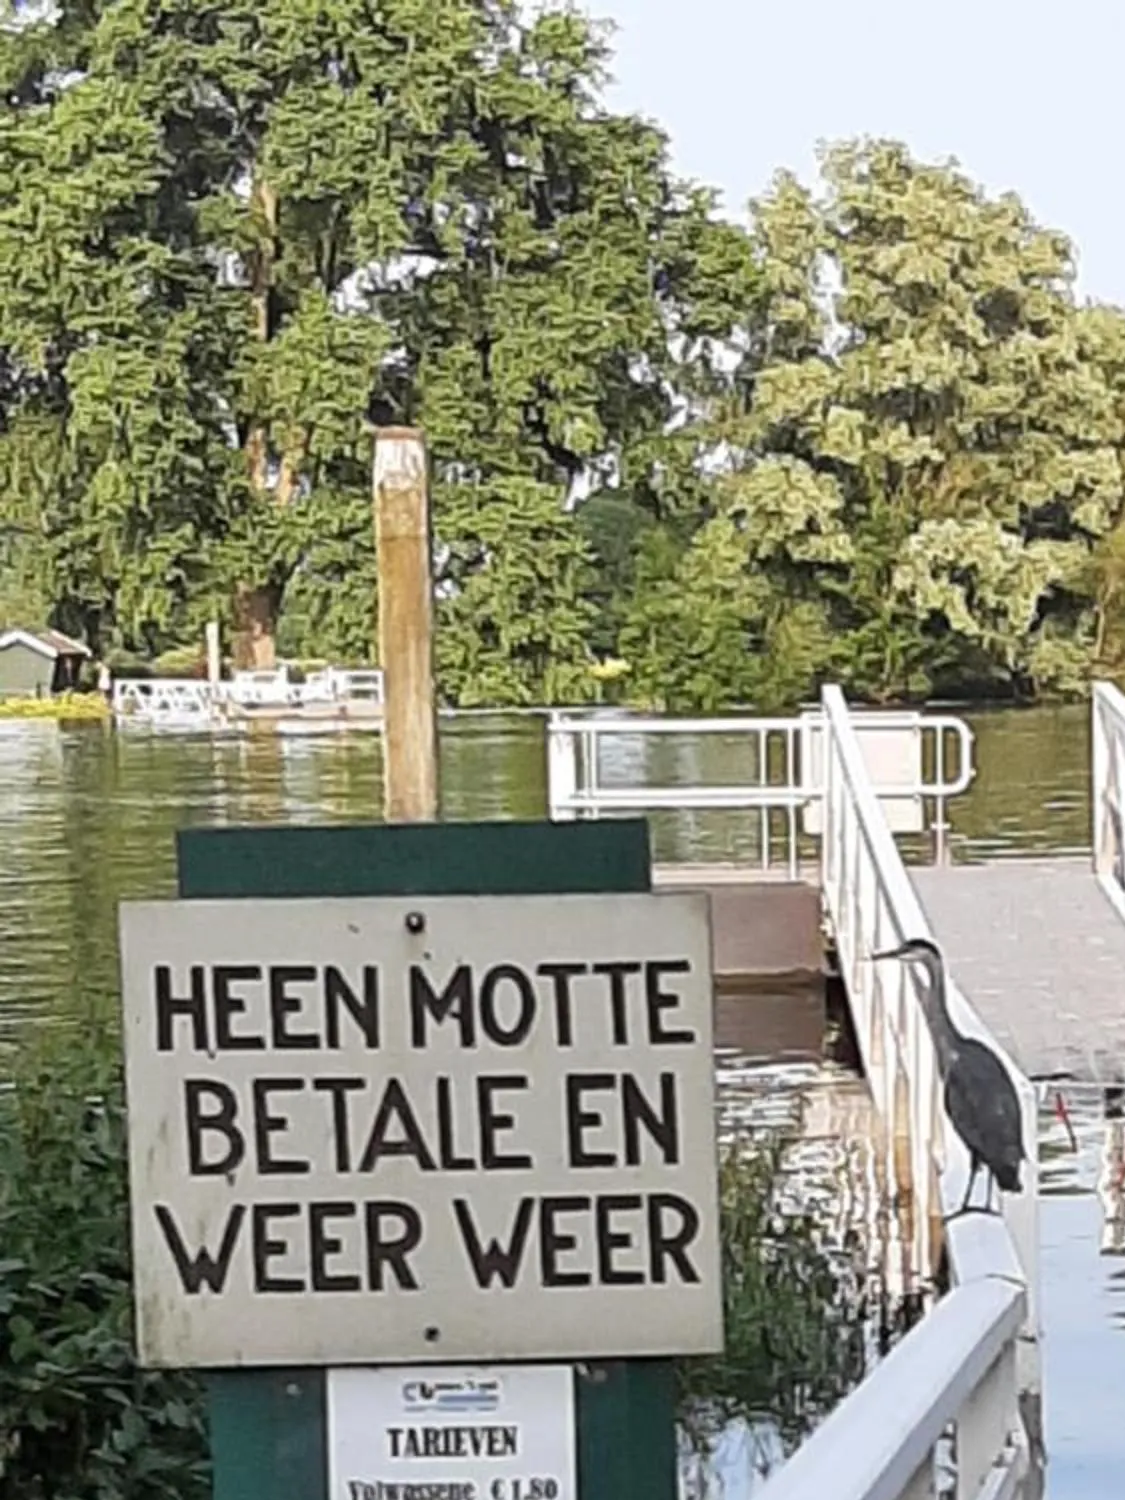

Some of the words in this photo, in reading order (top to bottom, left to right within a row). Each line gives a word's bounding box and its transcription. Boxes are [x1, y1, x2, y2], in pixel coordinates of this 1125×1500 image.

[154, 963, 380, 1051] HEEN
[409, 959, 696, 1048] MOTTE
[184, 1075, 533, 1176] BETALE
[565, 1071, 680, 1169] EN
[154, 1200, 423, 1294] WEER
[452, 1194, 702, 1289] WEER
[387, 1426, 518, 1457] TARIEVEN
